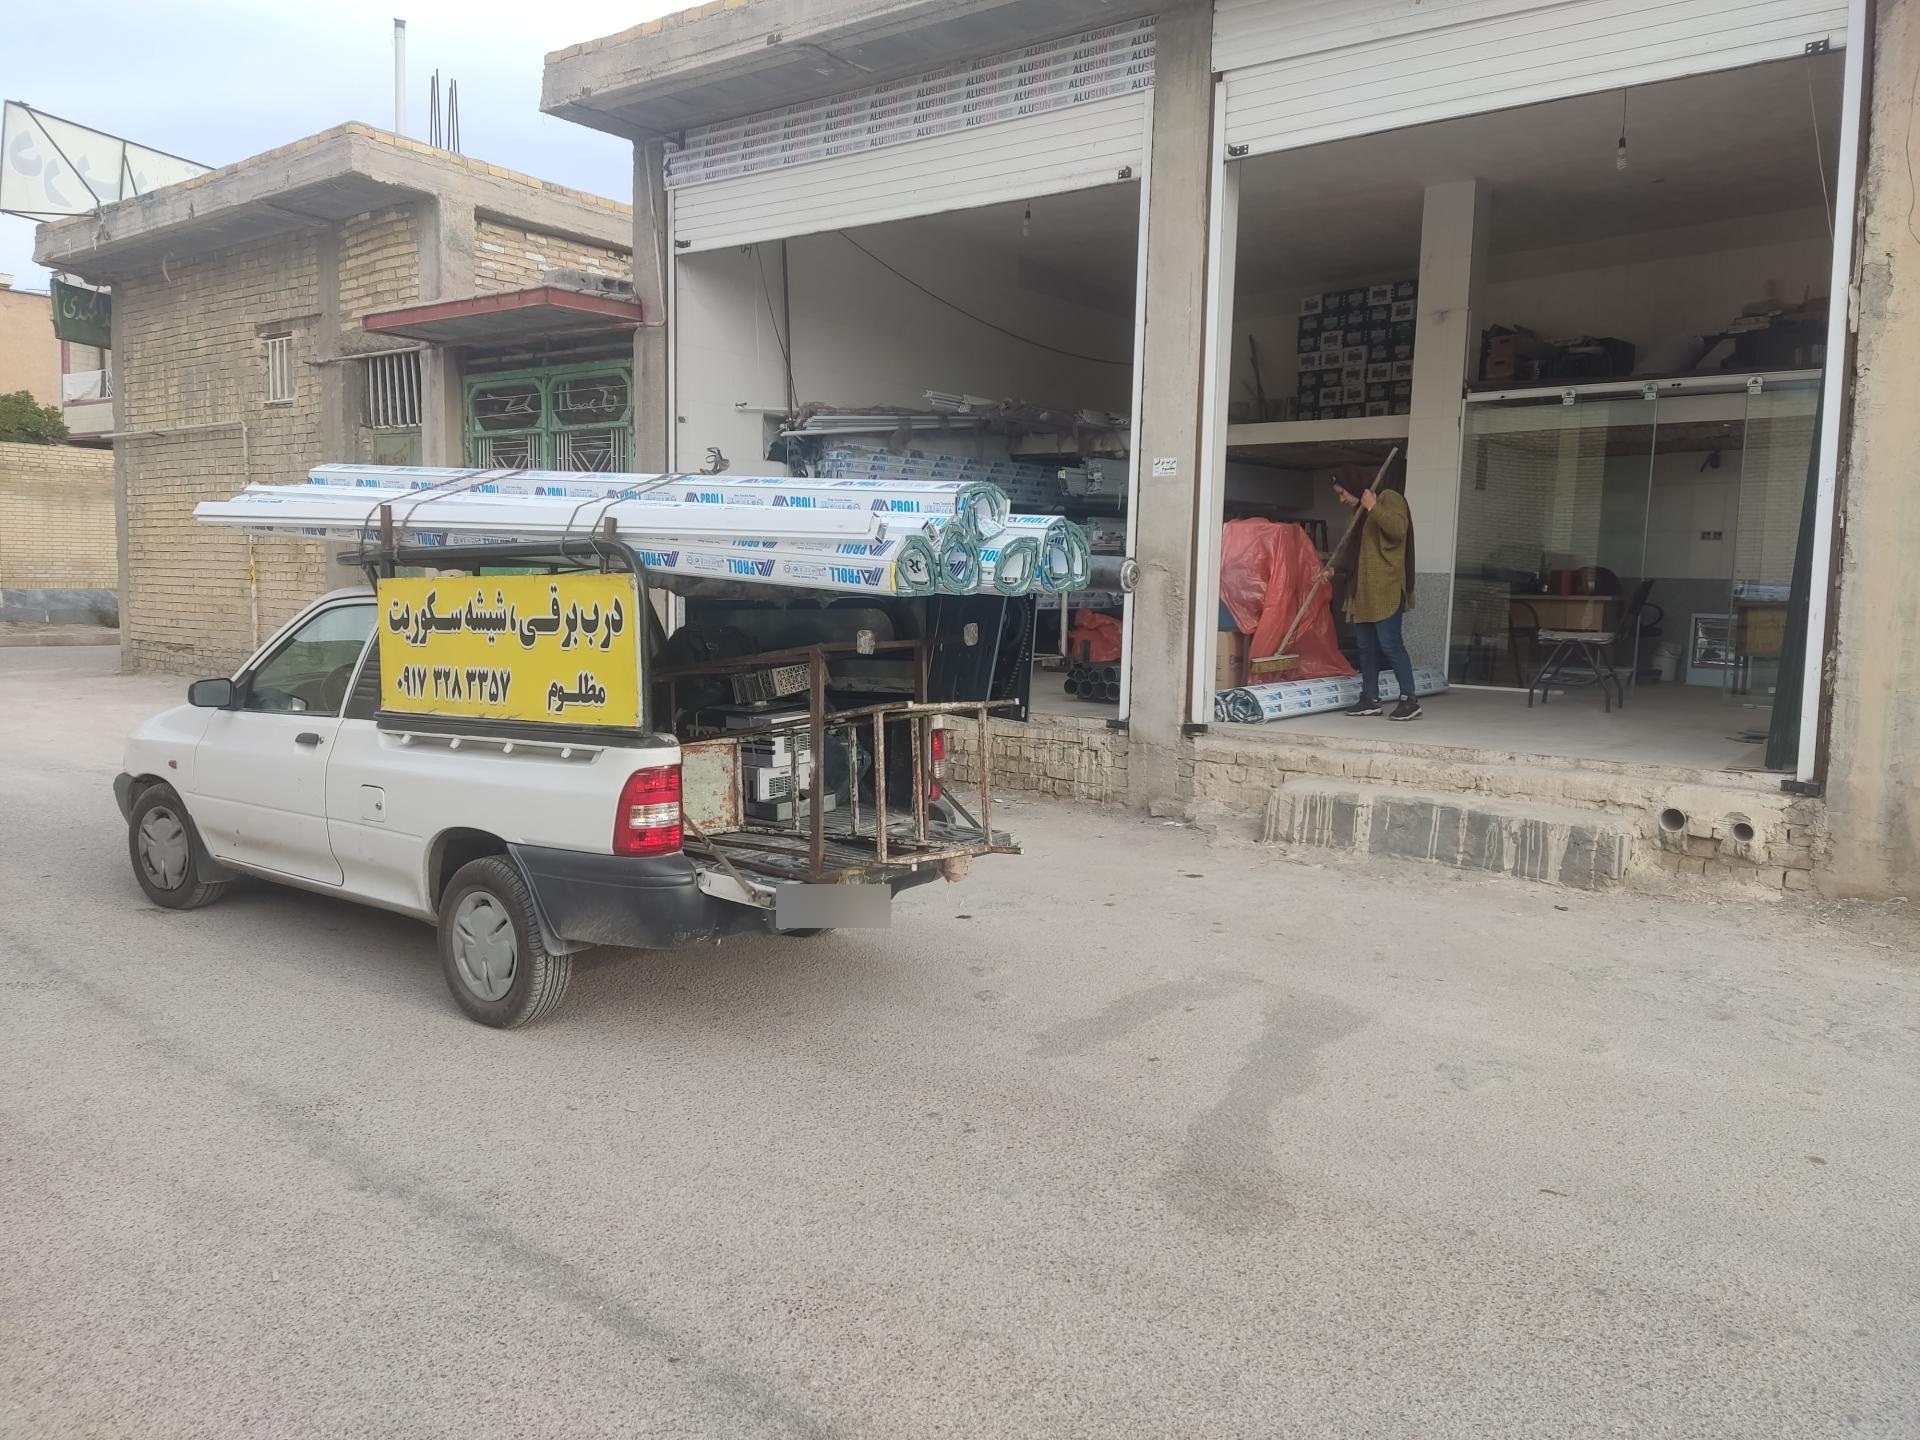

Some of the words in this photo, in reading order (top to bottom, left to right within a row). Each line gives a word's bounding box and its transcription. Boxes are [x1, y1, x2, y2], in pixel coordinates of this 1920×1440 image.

[744, 126, 768, 138] ALUSUN
[784, 118, 810, 129] ALUSUN
[826, 106, 853, 120] ALUSUN
[870, 96, 898, 109] ALUSUN
[916, 85, 946, 98] ALUSUN
[966, 72, 997, 86] ALUSUN
[1018, 58, 1050, 74] ALUSUN
[1073, 44, 1108, 61] ALUSUN
[1131, 32, 1156, 46] ALUS
[831, 92, 858, 104] ALUSUN
[875, 82, 903, 94] ALUSUN
[922, 70, 951, 83] ALUSUN
[972, 57, 1002, 70] ALUSUN
[1024, 43, 1058, 58] ALUSUN
[1080, 28, 1115, 44] ALUSUN
[1139, 15, 1160, 28] ALU
[740, 149, 765, 161] ALUSUN
[781, 141, 806, 152] ALUSUN
[823, 132, 850, 144] ALUSUN
[867, 122, 895, 134] ALUSUN
[914, 110, 943, 124] ALUSUN
[962, 98, 994, 114] ALUSUN
[1014, 87, 1047, 102] ALUSUN
[1068, 73, 1103, 89] ALUSUN
[1126, 61, 1155, 76] ALUSU
[742, 137, 768, 149] ALUSUN
[783, 128, 809, 140] ALUSUN
[826, 118, 852, 131] ALUSUN
[870, 109, 898, 122] ALUSUN
[916, 98, 946, 111] ALUSUN
[966, 85, 997, 100] ALUSUN
[1018, 72, 1050, 88] ALUSUN
[1073, 58, 1108, 74] ALUSUN
[1132, 48, 1156, 61] ALUS
[744, 161, 768, 172] ALUSUN
[784, 152, 810, 164] ALUSUN
[826, 144, 852, 156] ALUSUN
[870, 134, 898, 147] ALUSUN
[916, 122, 946, 138] ALUSUN
[966, 112, 998, 126] ALUSUN
[1018, 100, 1050, 116] ALUSUN
[1073, 87, 1109, 104] ALUSUN
[1132, 76, 1156, 90] ALUS
[547, 486, 567, 497] PROLL
[700, 492, 724, 504] PROLL
[789, 496, 816, 508] PROLL
[890, 500, 920, 513] PROLL
[416, 532, 435, 547] PROLL
[726, 558, 756, 576] PROLL
[829, 566, 862, 585] PROLL
[388, 591, 462, 645] سکوریت
[465, 590, 508, 644] شیشه
[581, 597, 624, 649] درب
[397, 665, 427, 698] ۰۹۱۷
[433, 666, 462, 700] ۳۲۸
[466, 668, 511, 703] ۳۳۵۷
[547, 671, 607, 712] مظلوم
